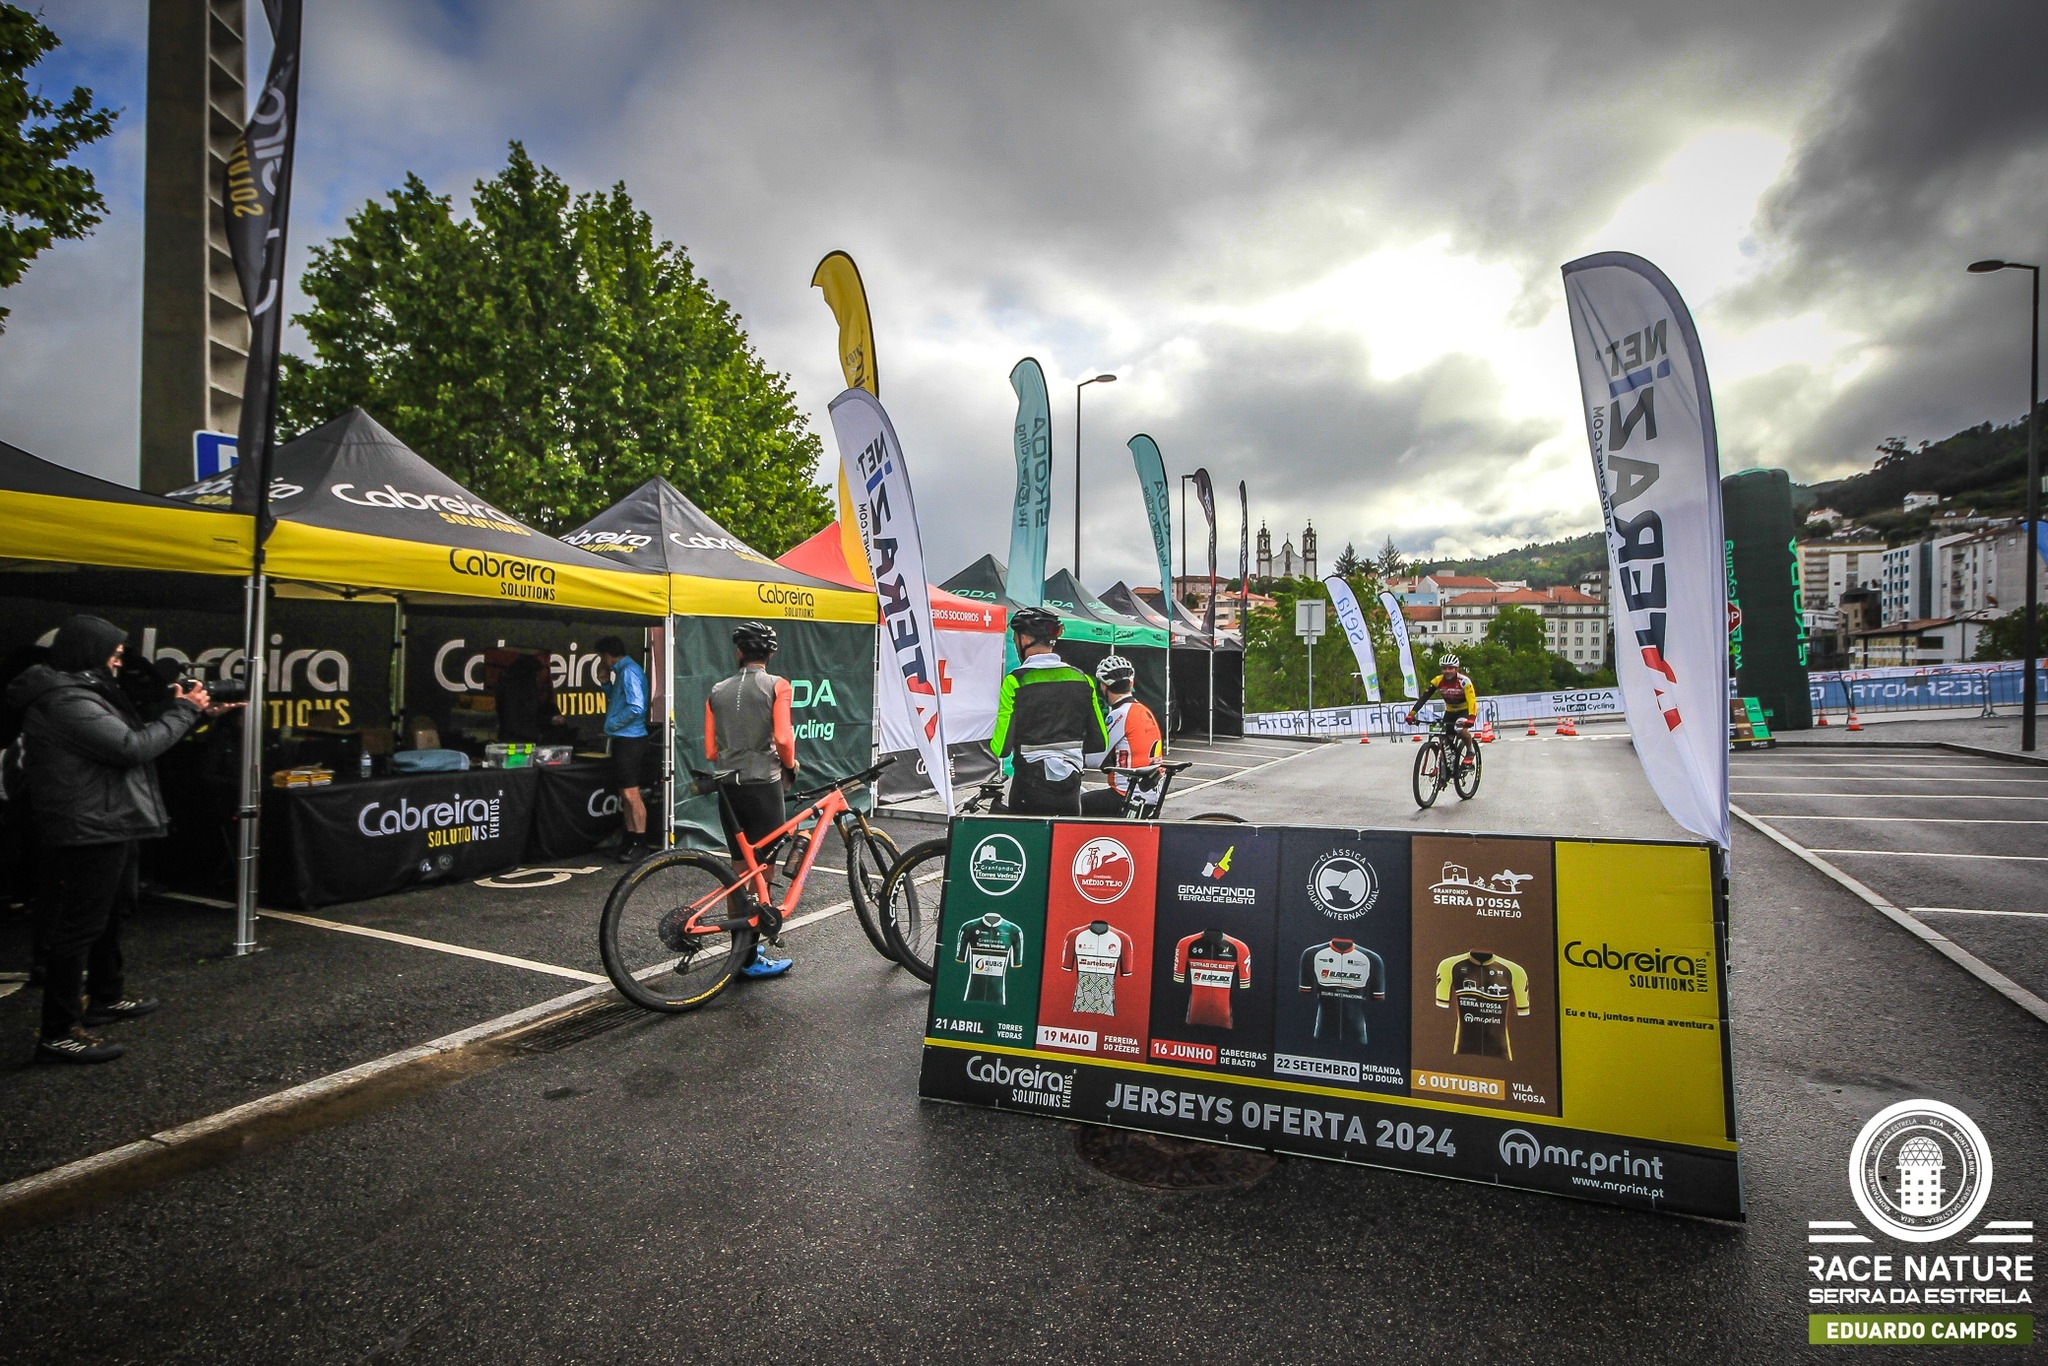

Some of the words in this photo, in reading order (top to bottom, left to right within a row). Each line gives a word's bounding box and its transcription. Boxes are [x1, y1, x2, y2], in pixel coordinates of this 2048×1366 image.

[331, 483, 517, 526] Cabreira
[438, 511, 532, 537] SOLUTIONS
[449, 548, 555, 585] Cabreira
[500, 581, 556, 601] SOLUTIONS
[757, 584, 815, 608] Cabreira
[784, 606, 815, 619] SOLUTIONS
[949, 611, 979, 622] SOCORROS
[1553, 706, 1566, 714] We
[1588, 702, 1616, 712] Cycling
[792, 719, 835, 741] ycling
[359, 793, 490, 837] Cabreira
[489, 798, 500, 838] EVENTOS
[428, 825, 488, 848] SOLUTIONS
[1319, 848, 1367, 864] CLÁSSICA
[980, 864, 1014, 872] Granfondo
[1081, 878, 1105, 887] MÉDIO
[1105, 880, 1123, 888] TEJO
[1178, 884, 1256, 898] GRANFONDO
[1178, 893, 1212, 902] TERRAS
[1213, 895, 1225, 903] DE
[1226, 896, 1255, 905] BASTO
[1306, 884, 1324, 911] DOURO
[1323, 889, 1380, 920] INTERNACIONAL
[1433, 896, 1474, 907] SERRA
[1476, 897, 1521, 909] D'OSSA
[1476, 908, 1522, 919] ALENTEJO
[1564, 941, 1695, 976] Cabreira
[1630, 974, 1695, 992] SOLUTIONS
[1696, 958, 1708, 992] EVENTOS
[1459, 1000, 1479, 1008] SERRA
[935, 1018, 948, 1030] 21
[950, 1019, 984, 1034] ABRIL
[998, 1022, 1023, 1032] TORRES
[1565, 1008, 1577, 1017] Eu
[1588, 1010, 1601, 1020] tu,
[1603, 1011, 1635, 1022] juntos
[1636, 1016, 1665, 1025] numa
[1667, 1019, 1715, 1030] aventura
[997, 1031, 1023, 1040] VEDRAS
[1044, 1030, 1057, 1041] 19
[1059, 1032, 1090, 1046] MAIO
[1104, 1035, 1139, 1046] FERREIRA
[1103, 1043, 1114, 1051] DO
[1154, 1043, 1168, 1055] 16
[1170, 1045, 1213, 1060] JUNHO
[1220, 1048, 1267, 1061] CABECEIRAS
[1220, 1057, 1231, 1065] DE
[1231, 1058, 1256, 1068] BASTO
[1276, 1058, 1290, 1070] 22
[1292, 1059, 1358, 1077] SETEMBRO
[1362, 1064, 1401, 1075] MIRANDA
[966, 1055, 1064, 1092] Cabreira
[1362, 1073, 1374, 1082] DO
[1375, 1074, 1404, 1085] DOURO
[1062, 1074, 1073, 1108] EVENTOS
[1418, 1074, 1427, 1086] 6
[1430, 1075, 1499, 1095] OUTUBRO
[1512, 1082, 1533, 1093] VILA
[1012, 1088, 1061, 1108] SOLUTIONS
[1512, 1092, 1546, 1105] VIÇOSA
[1105, 1083, 1233, 1124] JERSEYS
[1241, 1101, 1367, 1146] OFERTA
[1376, 1119, 1456, 1157] 2024
[1543, 1145, 1664, 1180] mr.print
[1571, 1176, 1664, 1199] www.mrprint.pt
